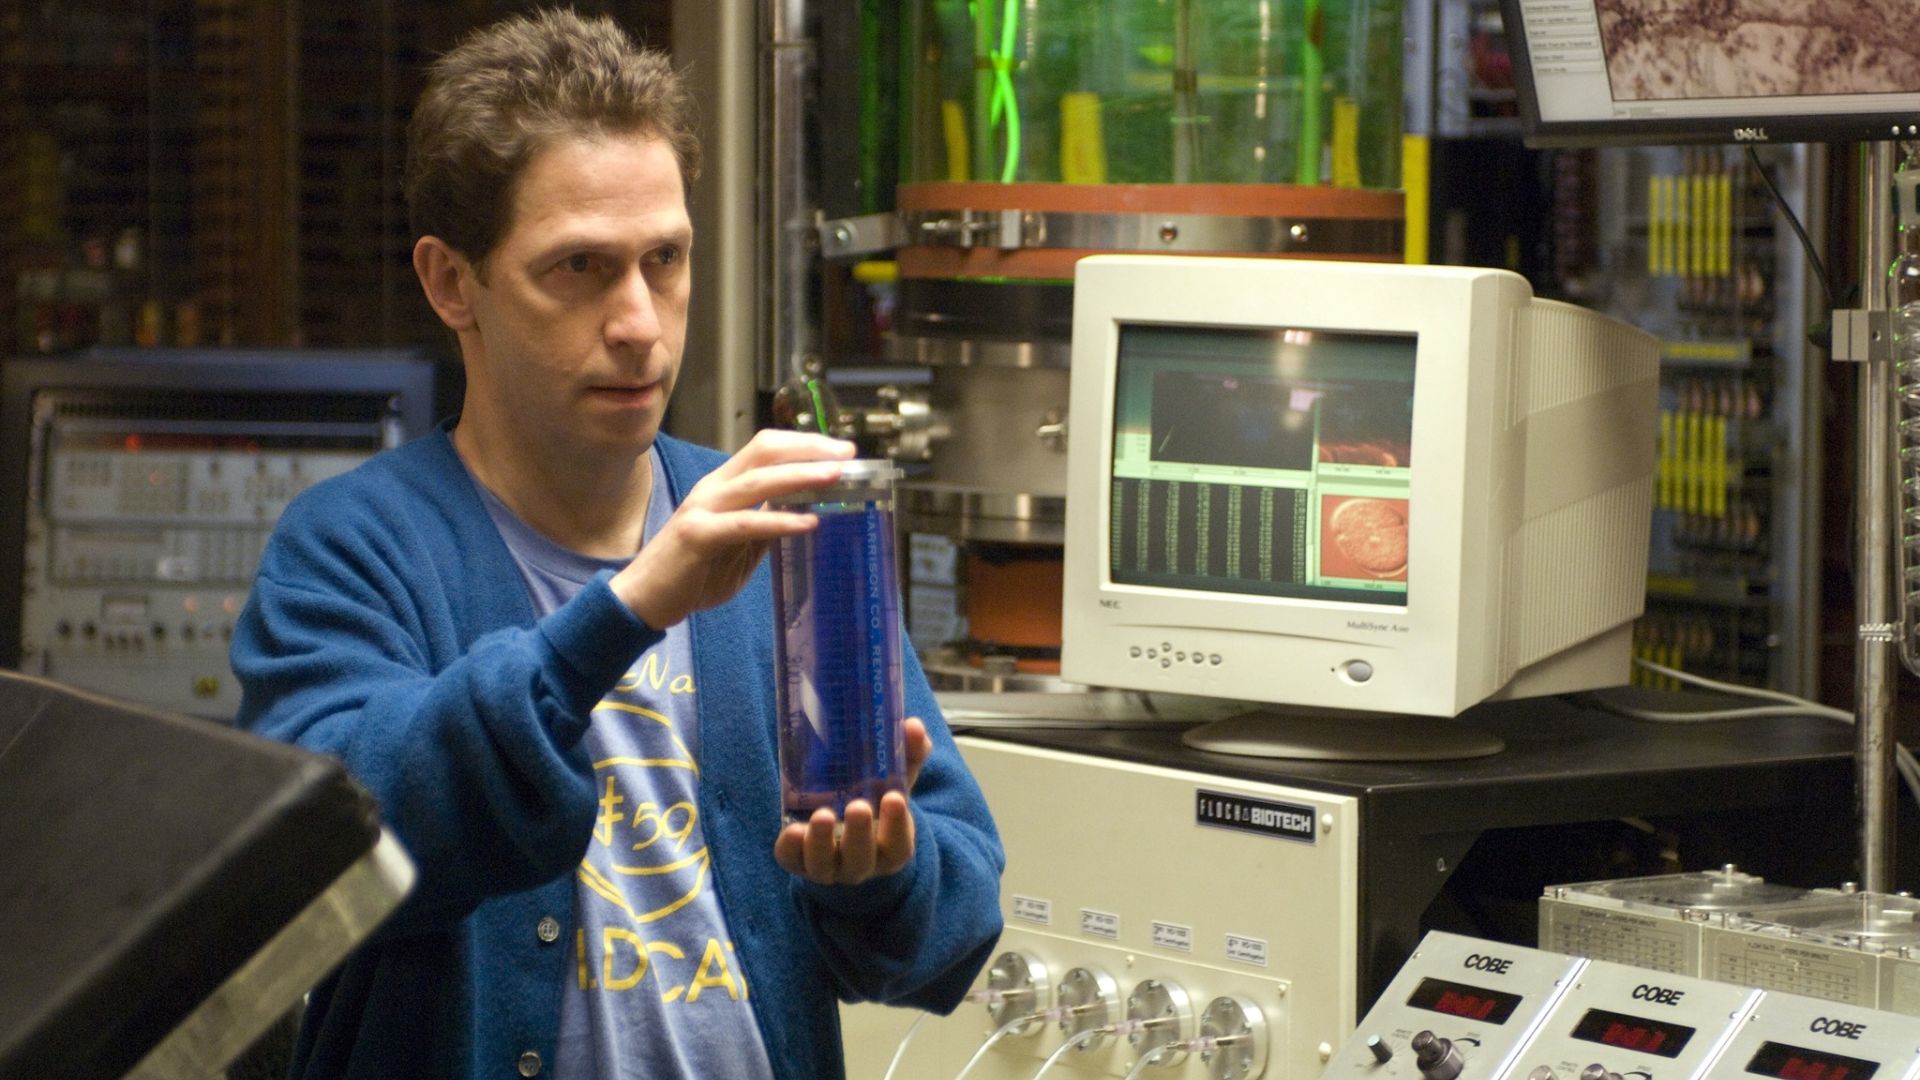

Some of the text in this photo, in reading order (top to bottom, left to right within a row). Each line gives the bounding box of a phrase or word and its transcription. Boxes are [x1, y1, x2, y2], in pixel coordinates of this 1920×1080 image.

[1733, 127, 1768, 141] DELL
[866, 511, 880, 598] HARRISON
[1099, 599, 1121, 610] NEC
[871, 645, 882, 699] RENO,
[874, 705, 887, 772] NEVADA
[1250, 807, 1312, 833] BIOTECH
[1464, 953, 1514, 975] COBE
[1632, 984, 1685, 1006] COBE
[1810, 1016, 1867, 1040] COBE
